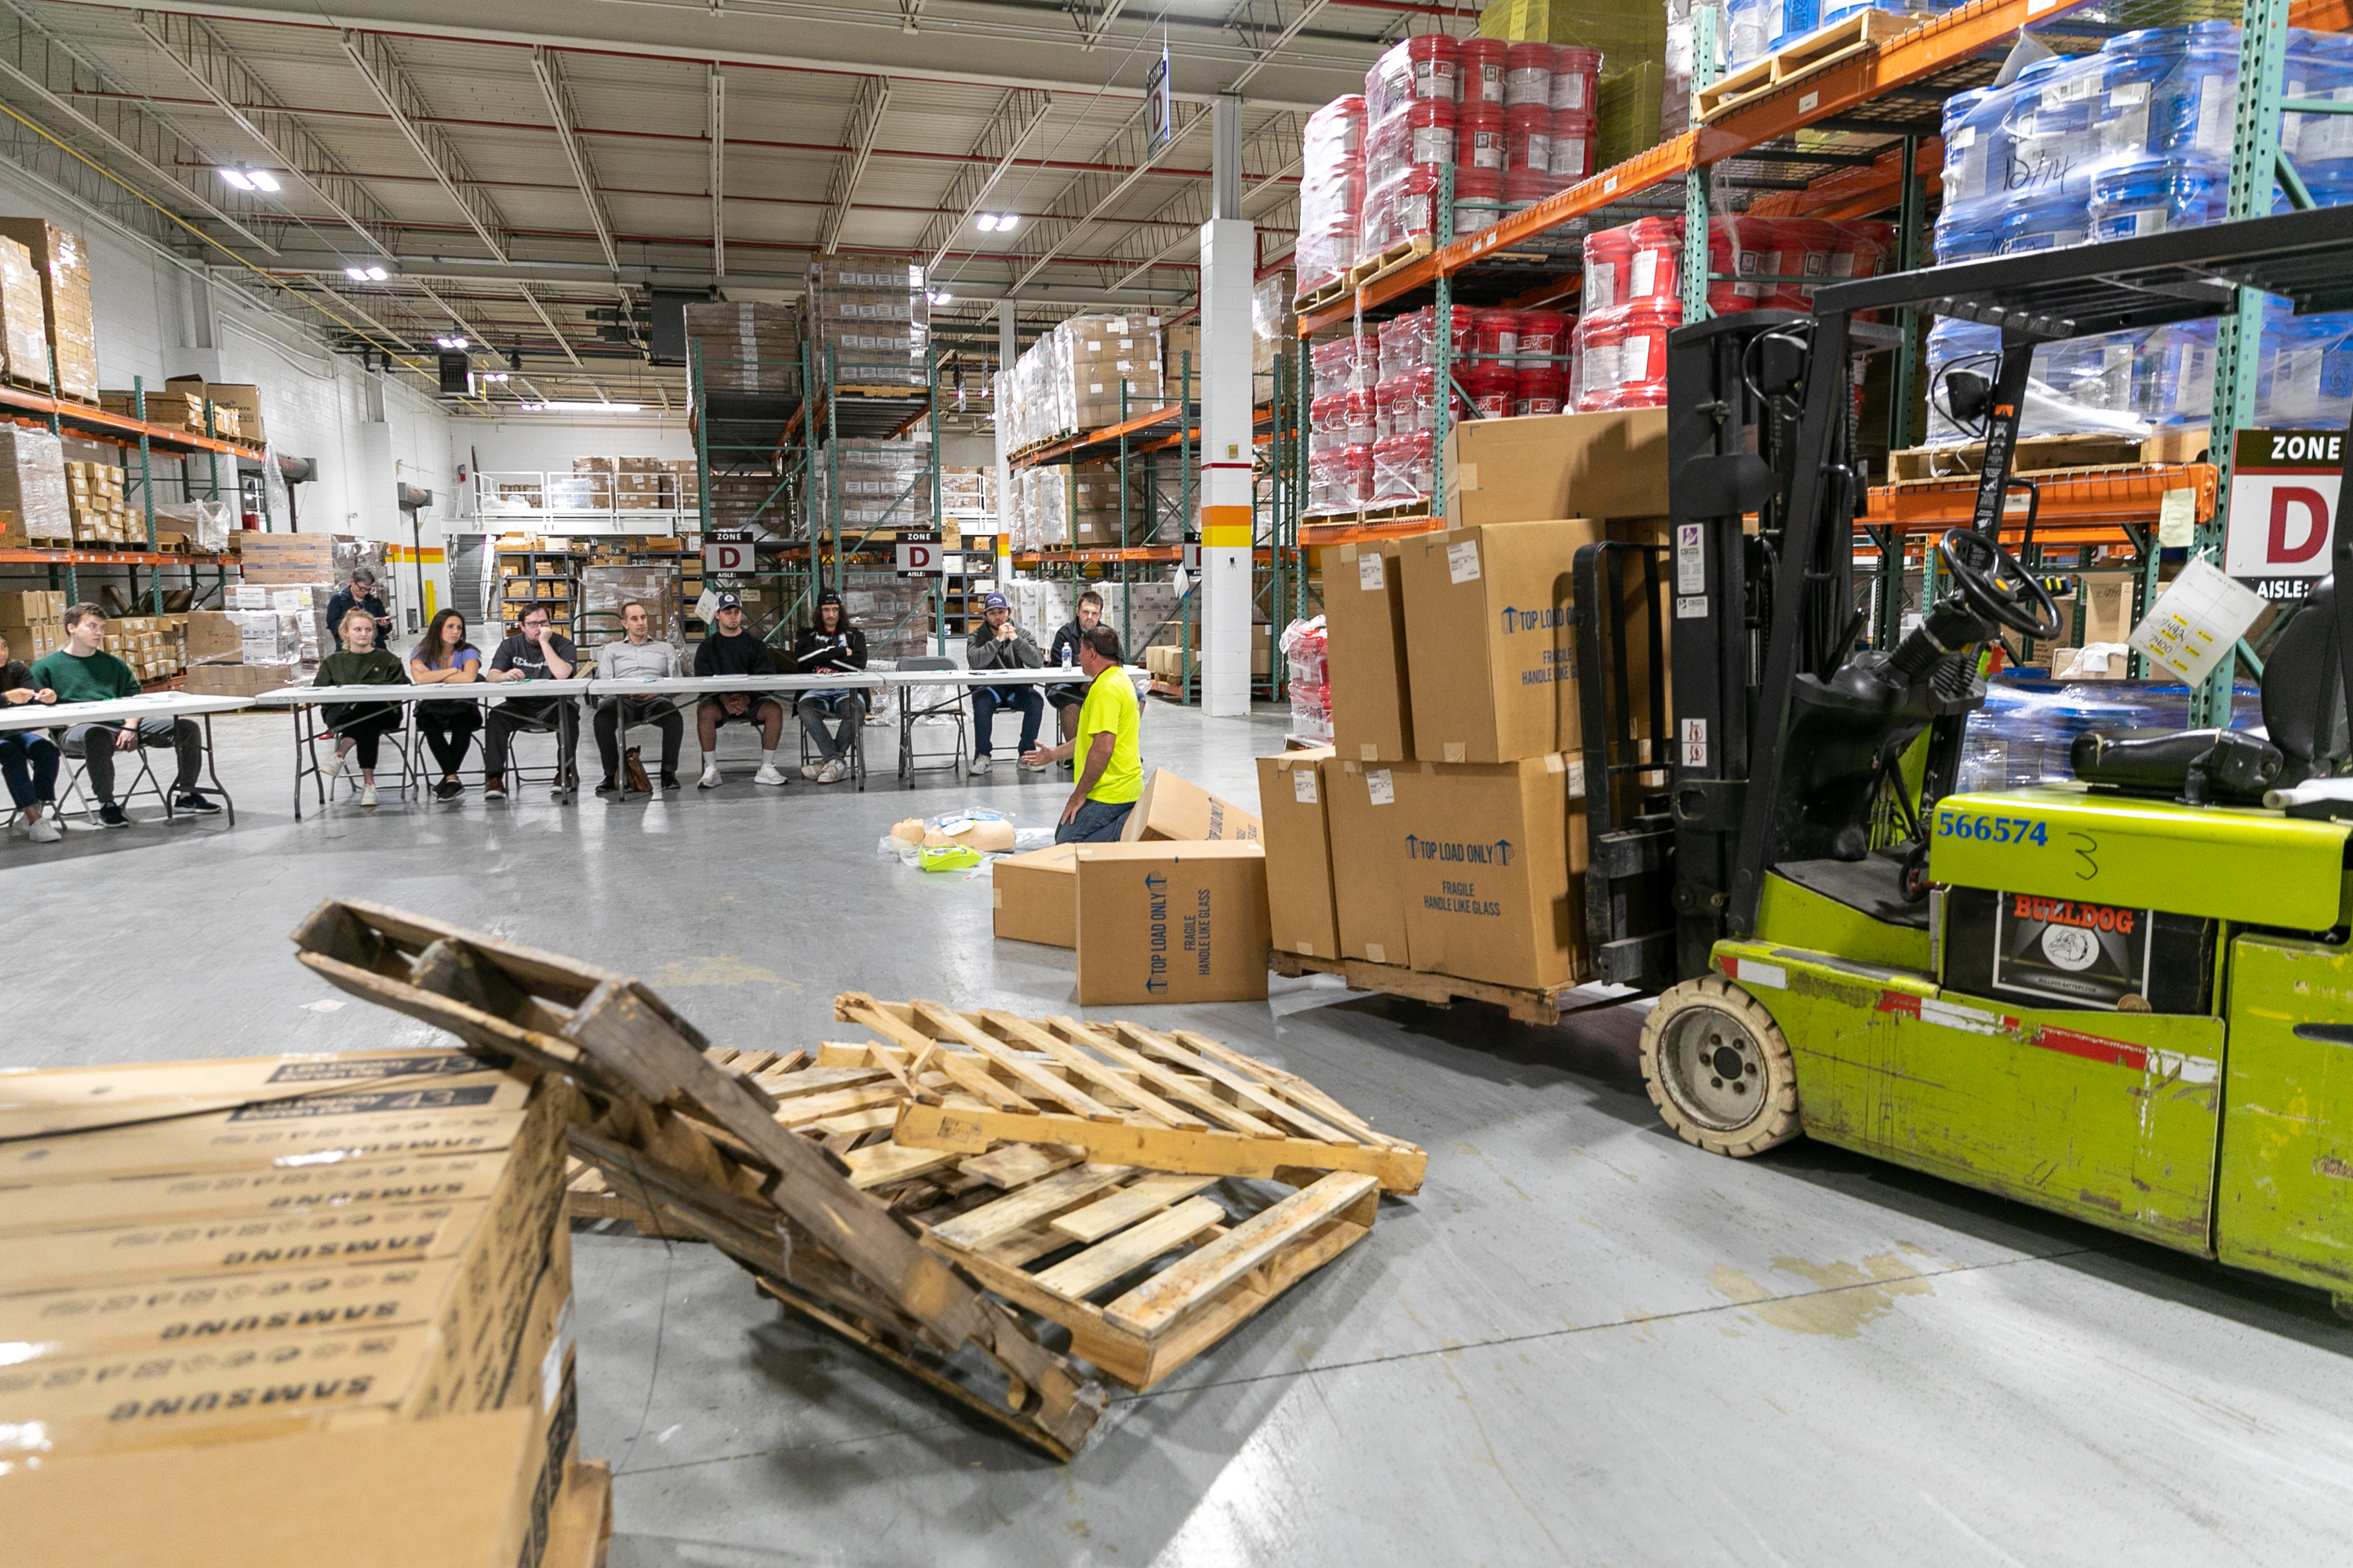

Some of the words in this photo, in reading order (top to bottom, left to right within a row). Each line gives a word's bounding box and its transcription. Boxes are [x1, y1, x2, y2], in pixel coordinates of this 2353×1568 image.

[1149, 60, 1164, 89] ZONE
[1153, 89, 1162, 135] D
[2271, 435, 2341, 460] ZONE
[2266, 486, 2329, 564] D
[719, 547, 741, 569] D
[909, 546, 930, 568] D
[2256, 580, 2310, 598] AISLE:
[1519, 610, 1538, 631] TOP
[1540, 607, 1564, 629] LOAD
[1543, 647, 1572, 664] FRAGILE
[1521, 668, 1553, 686] HANDLE
[1553, 665, 1570, 682] LIKE
[1937, 812, 2049, 847] 566574
[1420, 841, 1437, 860] TOP
[1439, 842, 1465, 862] LOAD
[1466, 844, 1493, 864] ONLY
[2067, 832, 2098, 880] 3
[1442, 881, 1475, 897] FRAGILE
[1150, 893, 1167, 921] ONLY
[1198, 889, 1210, 919] GLASS
[1423, 895, 1452, 911] HANDLE
[1453, 898, 1471, 914] LIKE
[1472, 900, 1501, 916] GLASS
[2013, 893, 2134, 934] BULLDOG
[1150, 923, 1167, 951] LOAD
[1184, 915, 1196, 951] FRAGILE
[1198, 920, 1210, 938] LIKE
[1150, 954, 1167, 975] TOP
[1198, 940, 1210, 976] HANDLE
[391, 1090, 456, 1108] 43
[268, 1182, 465, 1208] SAMSUNG
[222, 1231, 436, 1267] SAMSUNG
[160, 1301, 399, 1341] SAMSUNG
[107, 1374, 375, 1423] SAMSUNG
